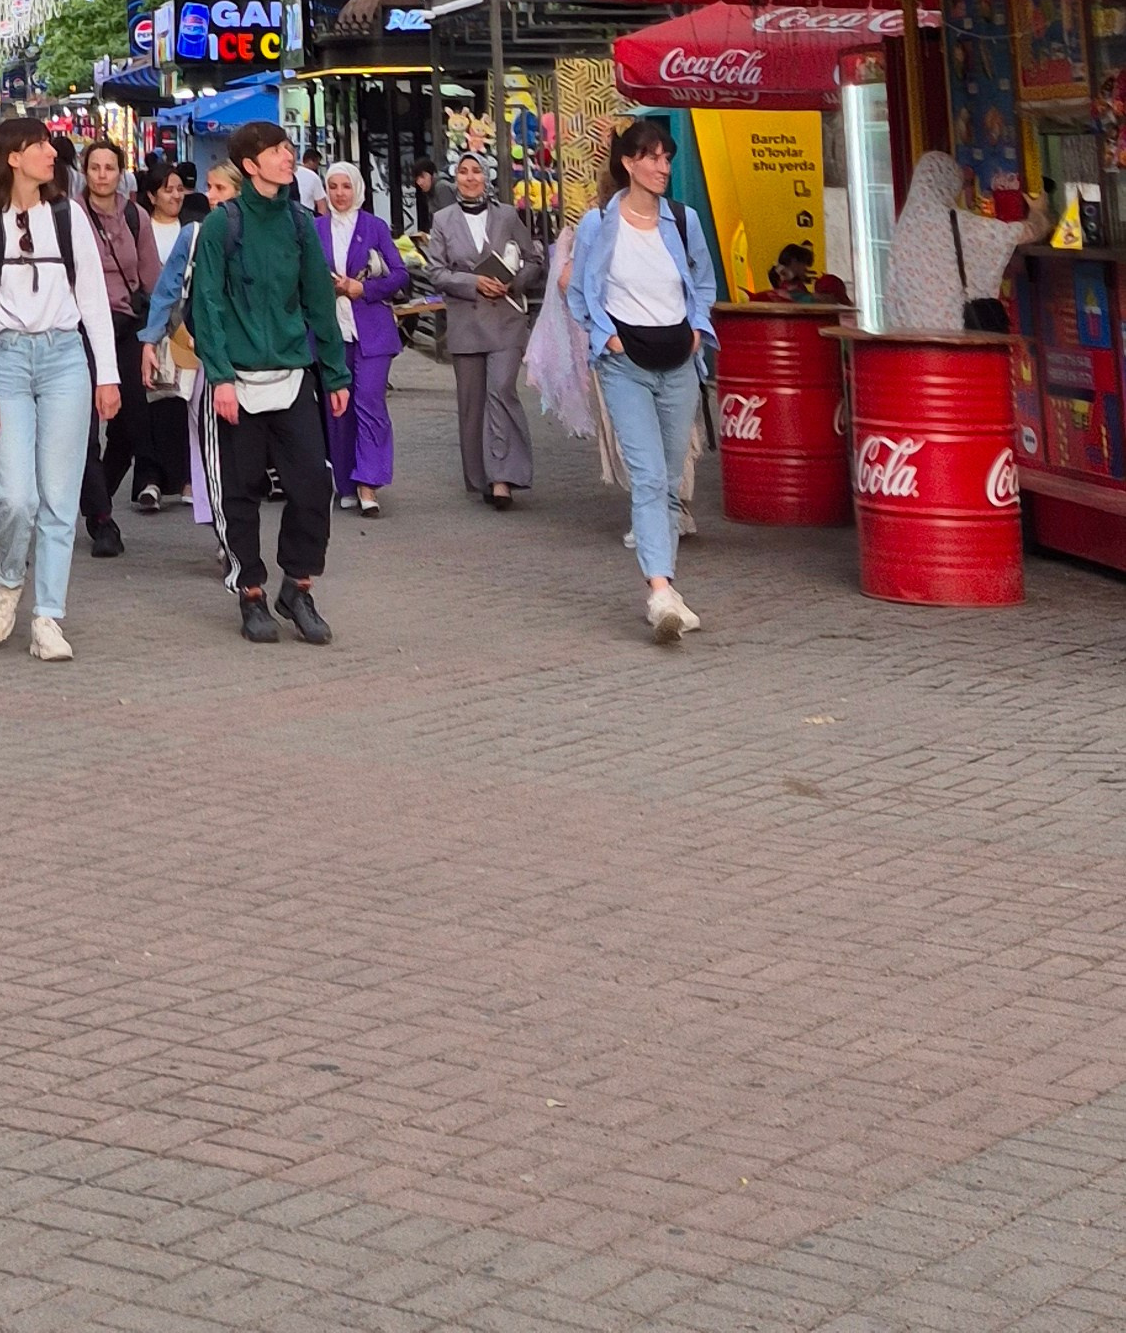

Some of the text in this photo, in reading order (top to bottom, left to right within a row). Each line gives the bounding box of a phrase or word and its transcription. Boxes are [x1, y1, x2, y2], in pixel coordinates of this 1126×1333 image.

[208, 32, 254, 60] ICE
[660, 47, 766, 85] Coca-Cola
[751, 133, 797, 144] Barcha
[753, 160, 816, 173] shu yerda
